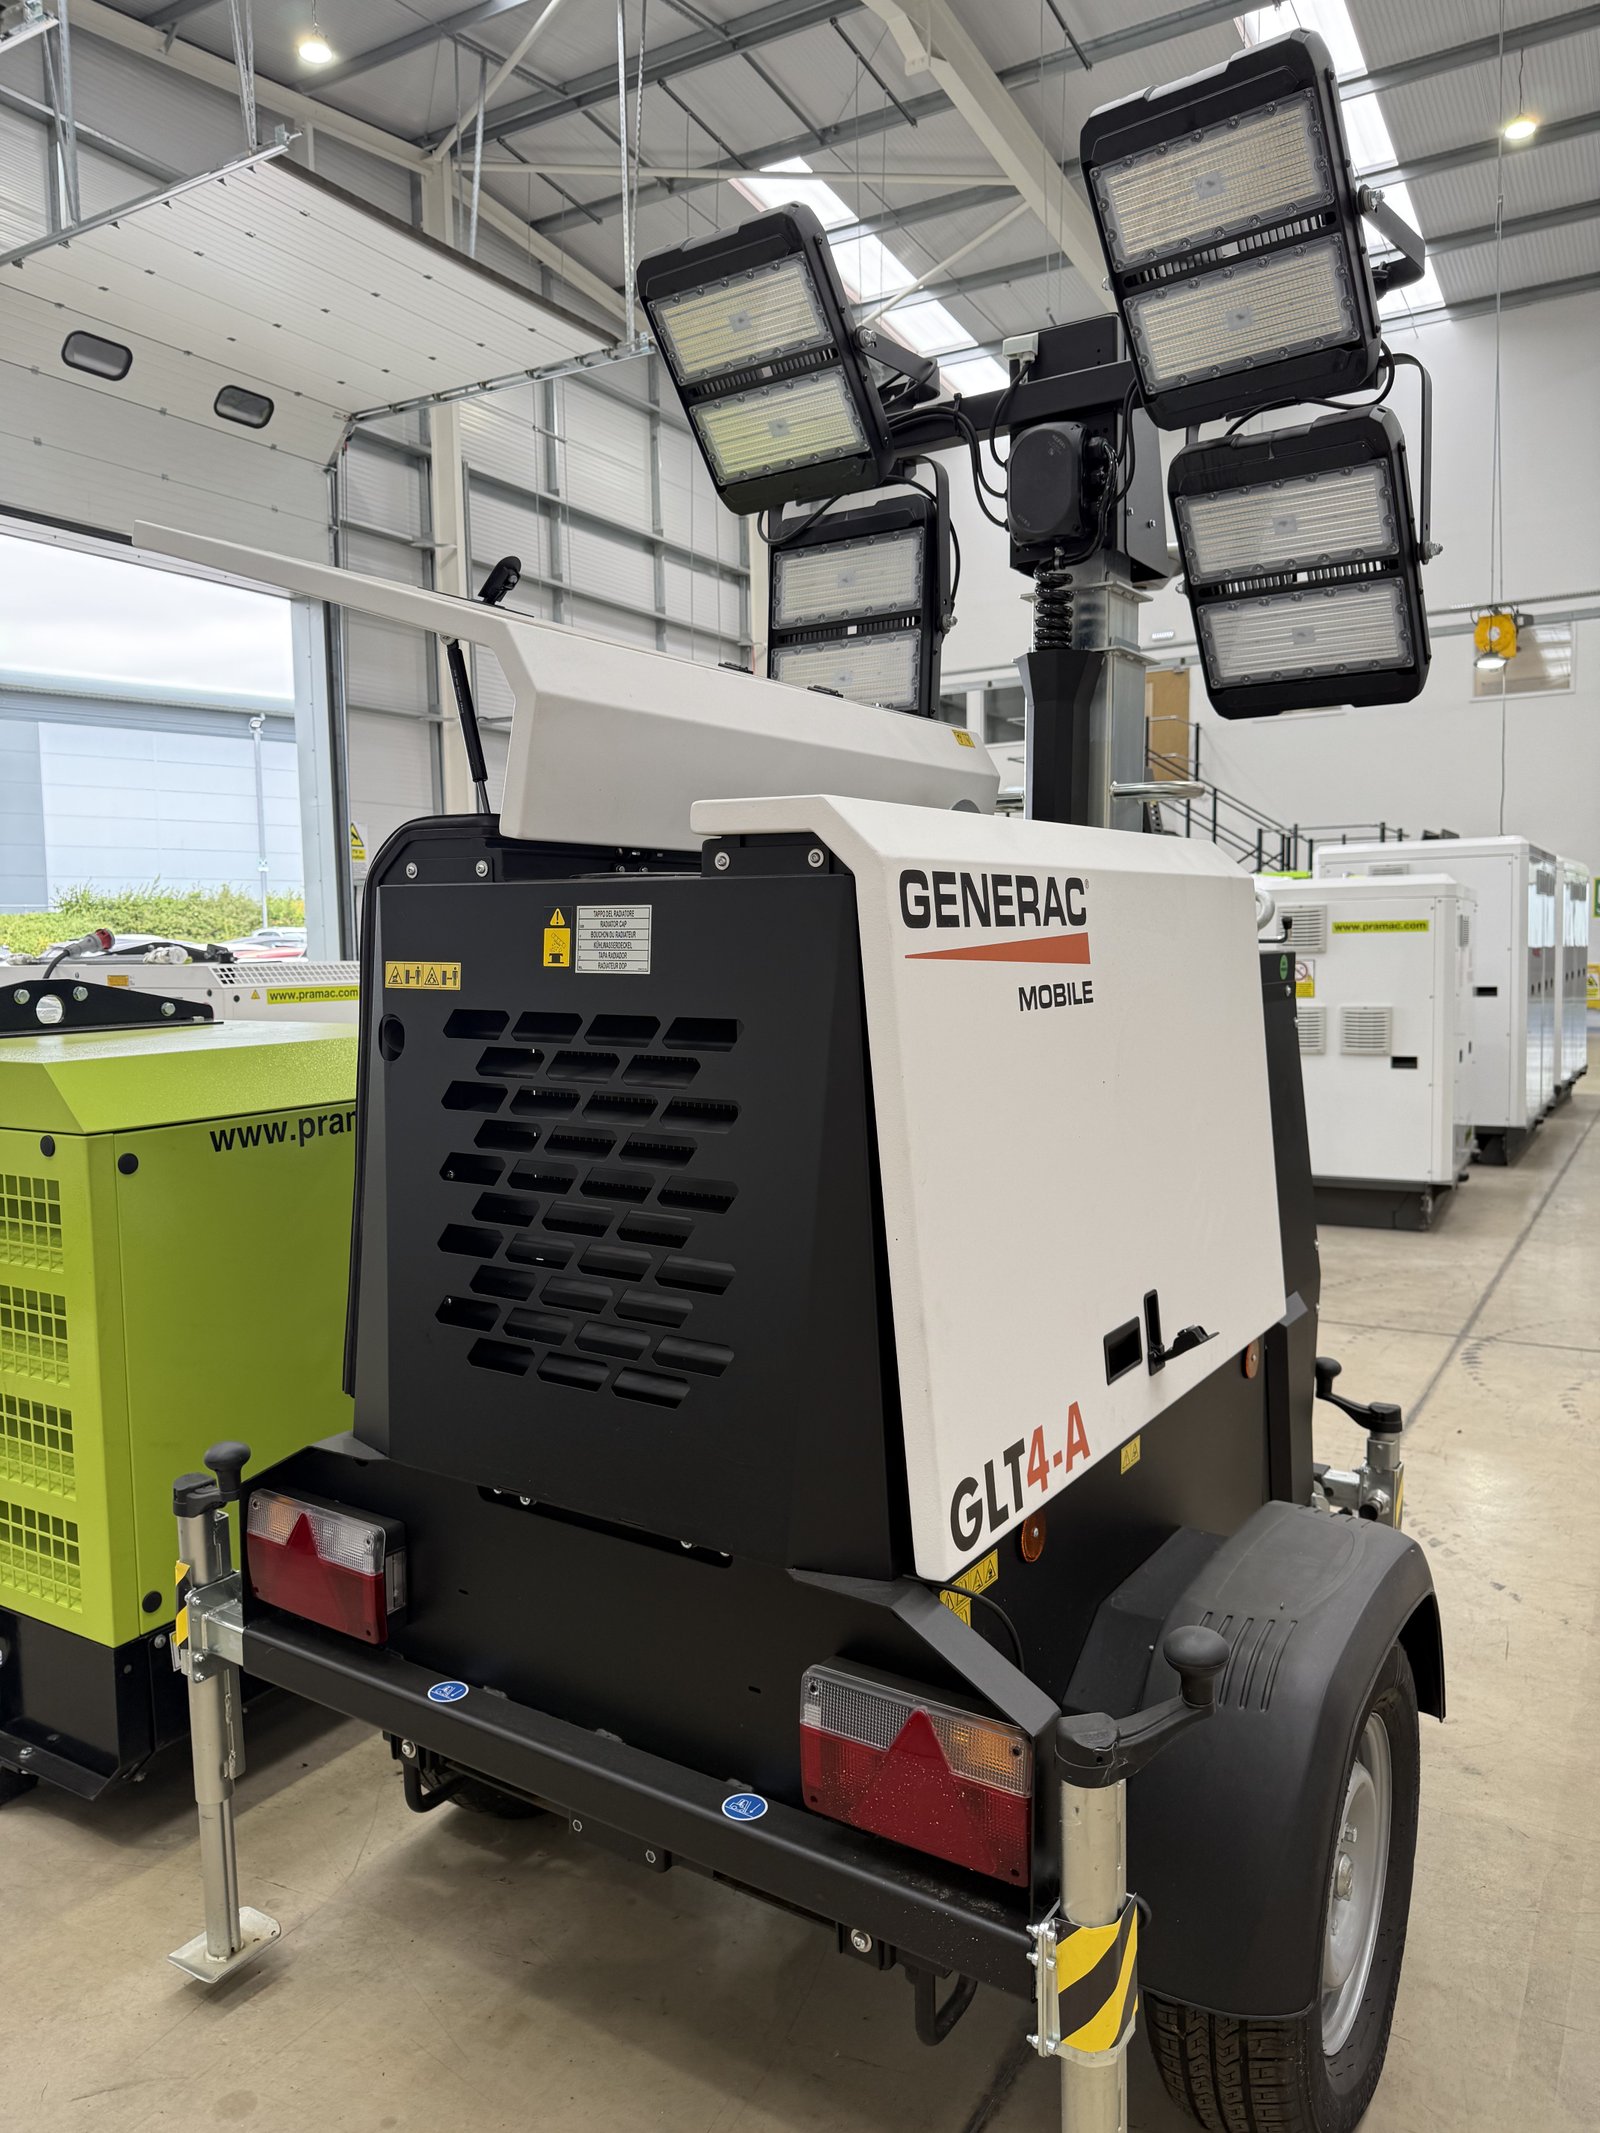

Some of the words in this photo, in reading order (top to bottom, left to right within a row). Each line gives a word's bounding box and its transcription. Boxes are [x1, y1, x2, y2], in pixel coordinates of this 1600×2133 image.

[1335, 922, 1426, 932] www.pramac.com
[269, 989, 358, 1001] www.pramac.com
[1018, 980, 1094, 1011] MOBILE
[950, 1401, 1091, 1552] GLT4-A
